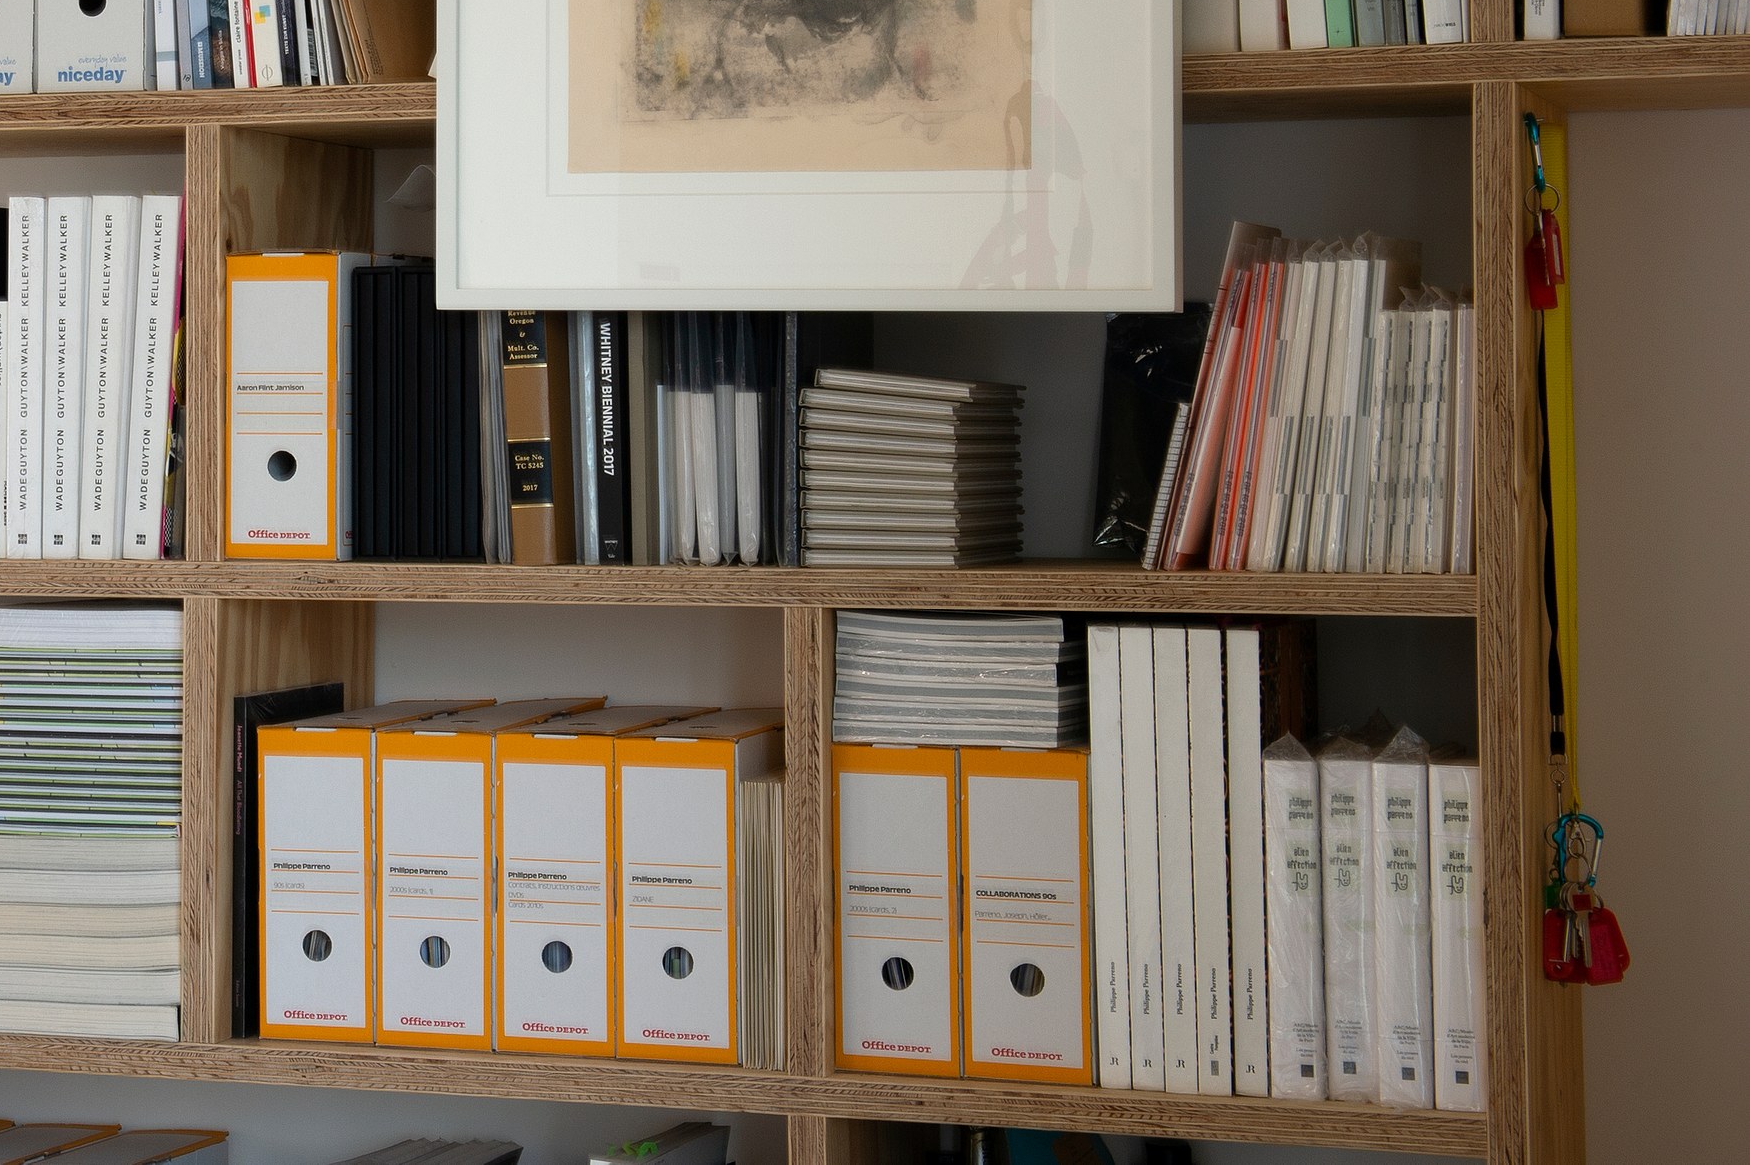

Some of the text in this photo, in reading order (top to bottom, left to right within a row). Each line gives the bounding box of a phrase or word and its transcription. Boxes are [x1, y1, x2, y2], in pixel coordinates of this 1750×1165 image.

[21, 263, 29, 307] KELLEY
[509, 317, 534, 326] Oregon
[507, 344, 539, 352] Mult. Co.
[509, 352, 538, 360] Assessor
[20, 318, 29, 418] GUYTON\WALKER
[599, 322, 614, 476] WHITNEY BIENNIAL 2017
[20, 429, 28, 478] GUYTON
[514, 453, 544, 462] Case No.
[515, 462, 544, 470] TC 5245
[522, 483, 538, 492] 2017
[19, 480, 27, 511] WADE
[248, 529, 278, 539] Office
[975, 890, 1041, 900] COLLABORATIONS
[284, 1010, 315, 1019] Office
[643, 1029, 708, 1041] Office DEPOT
